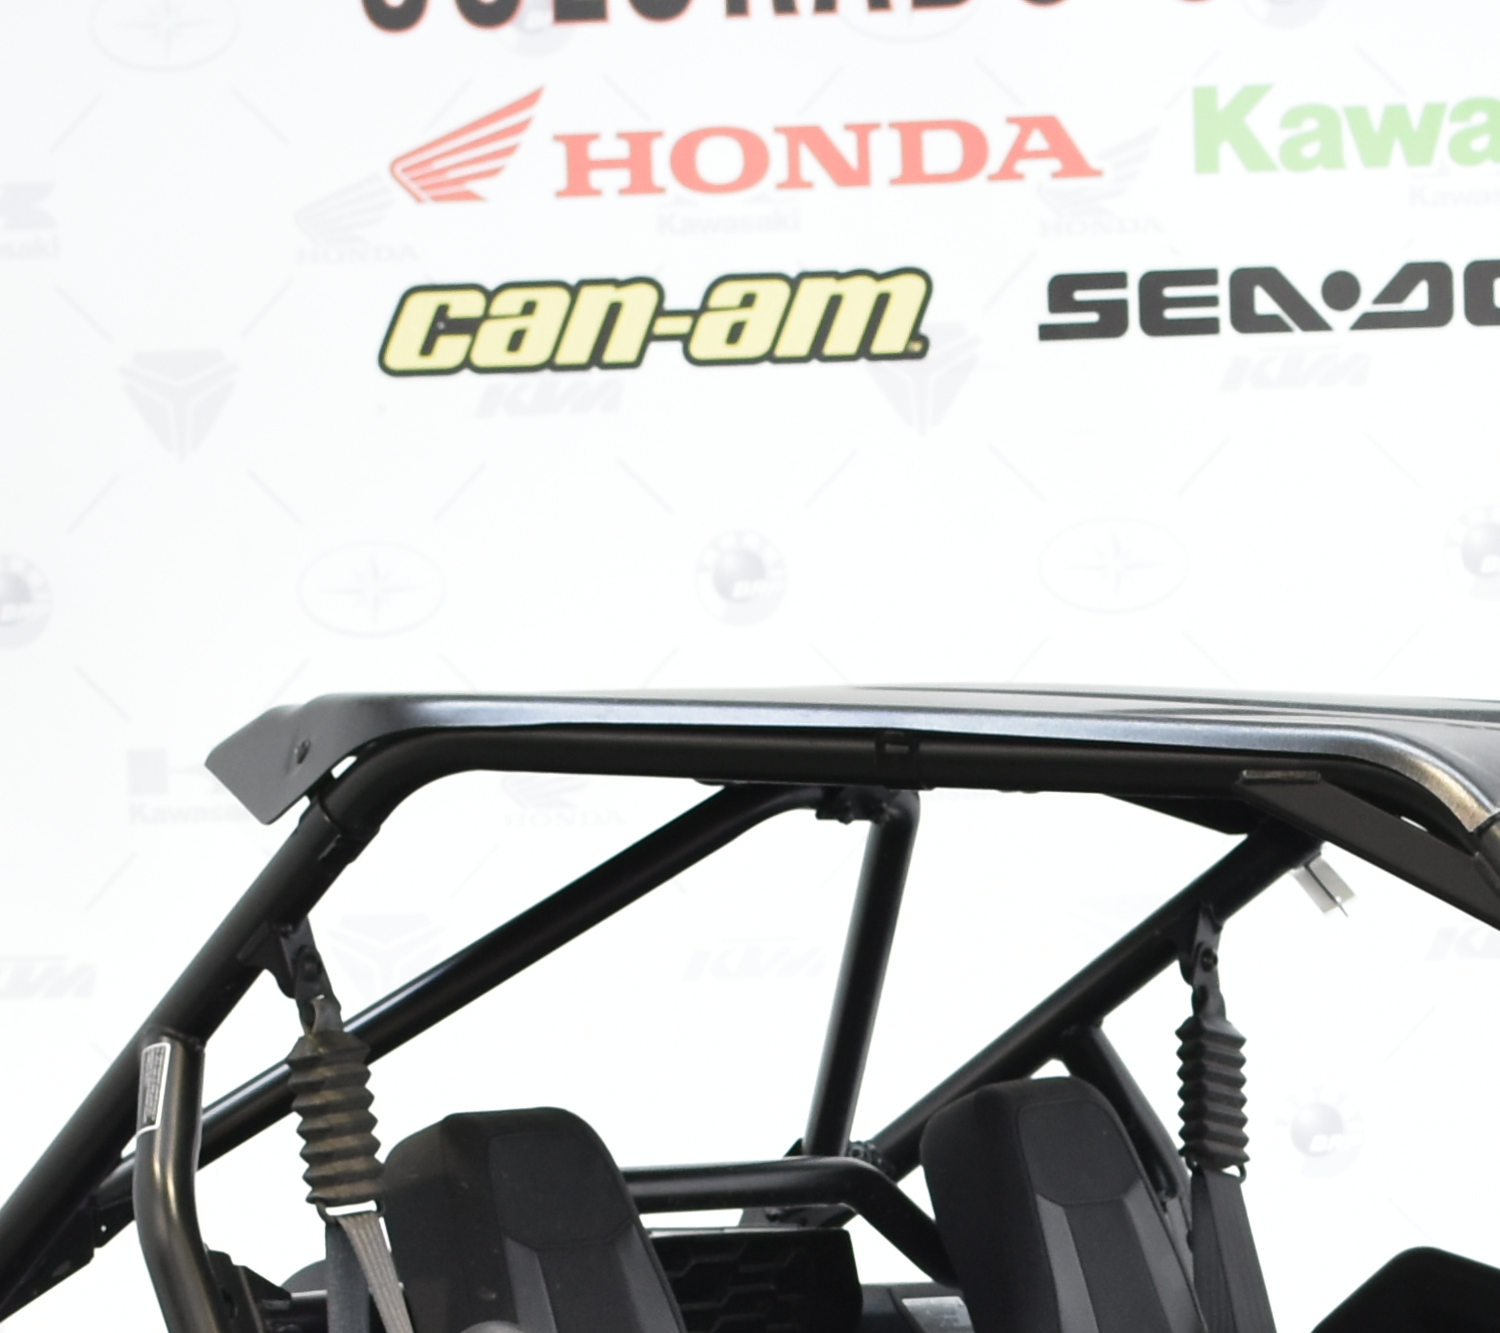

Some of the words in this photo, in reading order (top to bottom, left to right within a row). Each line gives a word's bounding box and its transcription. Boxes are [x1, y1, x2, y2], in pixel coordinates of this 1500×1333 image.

[552, 113, 1104, 198] HONDA
[378, 265, 933, 377] can-am
[1220, 345, 1370, 391] KTM
[474, 379, 623, 417] KTM
[681, 937, 826, 980] KTM
